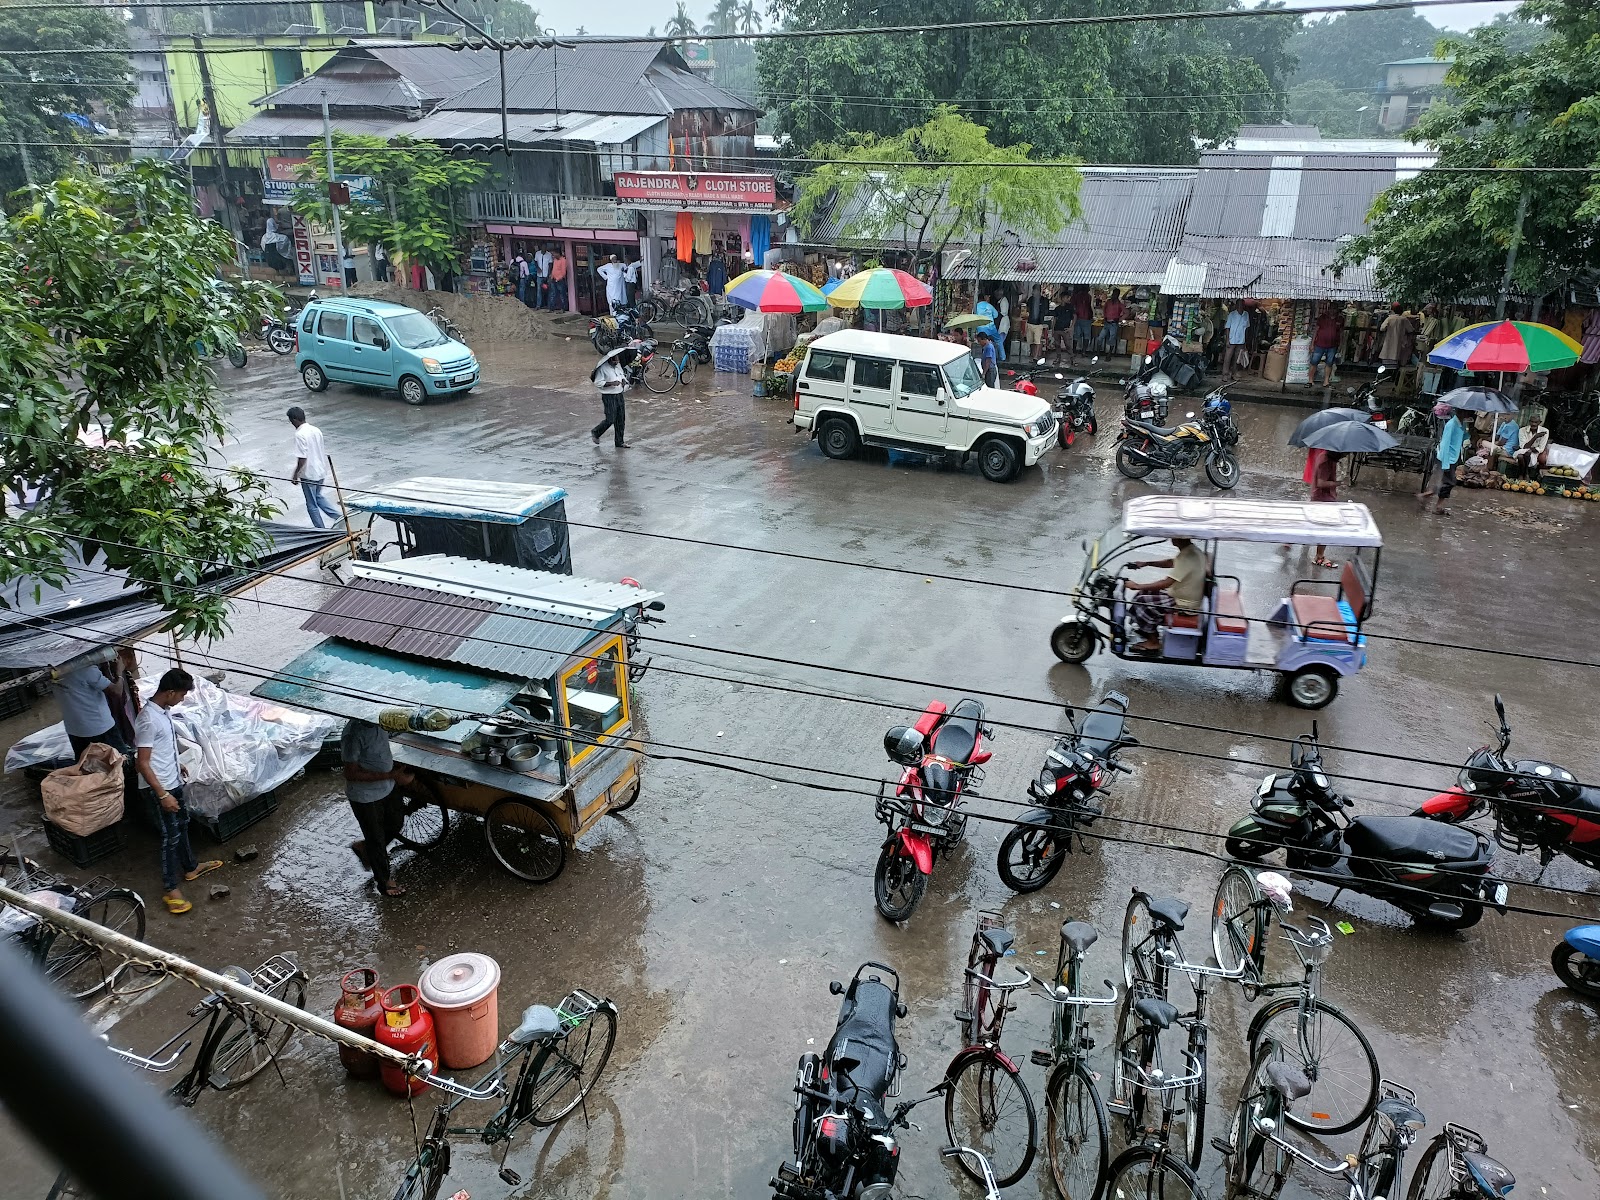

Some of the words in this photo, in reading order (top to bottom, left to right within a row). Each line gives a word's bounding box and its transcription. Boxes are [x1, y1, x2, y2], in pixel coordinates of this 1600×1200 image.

[265, 181, 296, 190] STUDIO
[618, 177, 680, 190] RAJENDRA
[705, 180, 737, 191] CLOTH
[740, 182, 772, 193] STORE
[294, 216, 312, 274] XEROX
